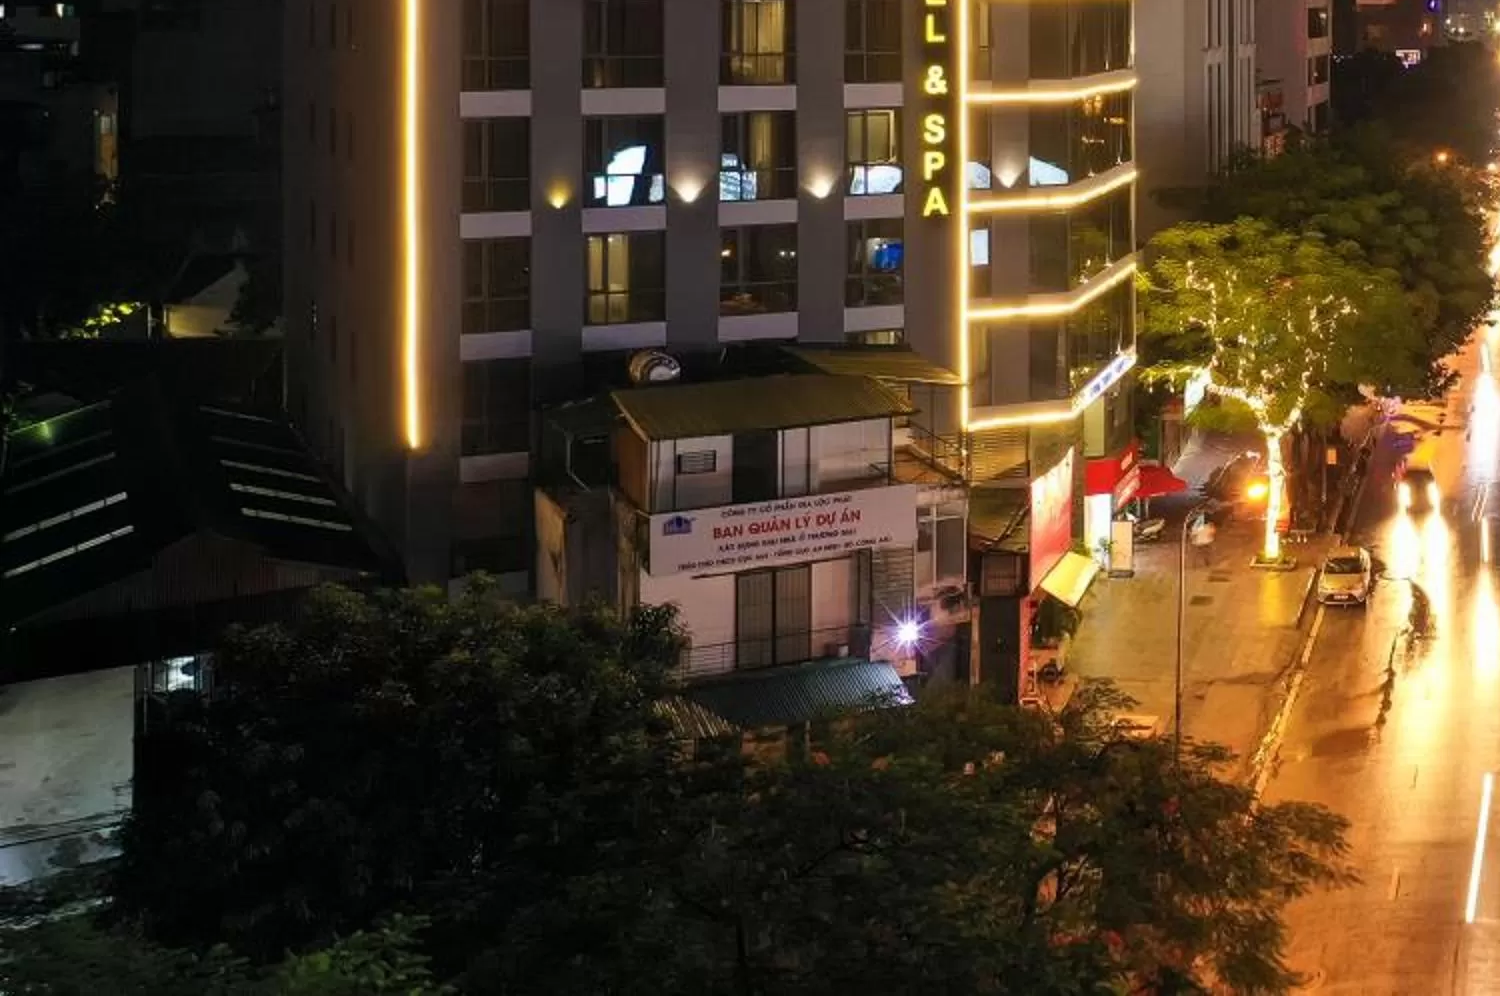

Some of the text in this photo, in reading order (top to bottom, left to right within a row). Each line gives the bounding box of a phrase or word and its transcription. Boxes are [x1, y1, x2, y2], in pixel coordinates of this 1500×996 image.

[923, 64, 948, 96] &
[922, 113, 949, 218] SPA
[713, 508, 861, 540] BAN QUẢN LÝ DỰ ÁN
